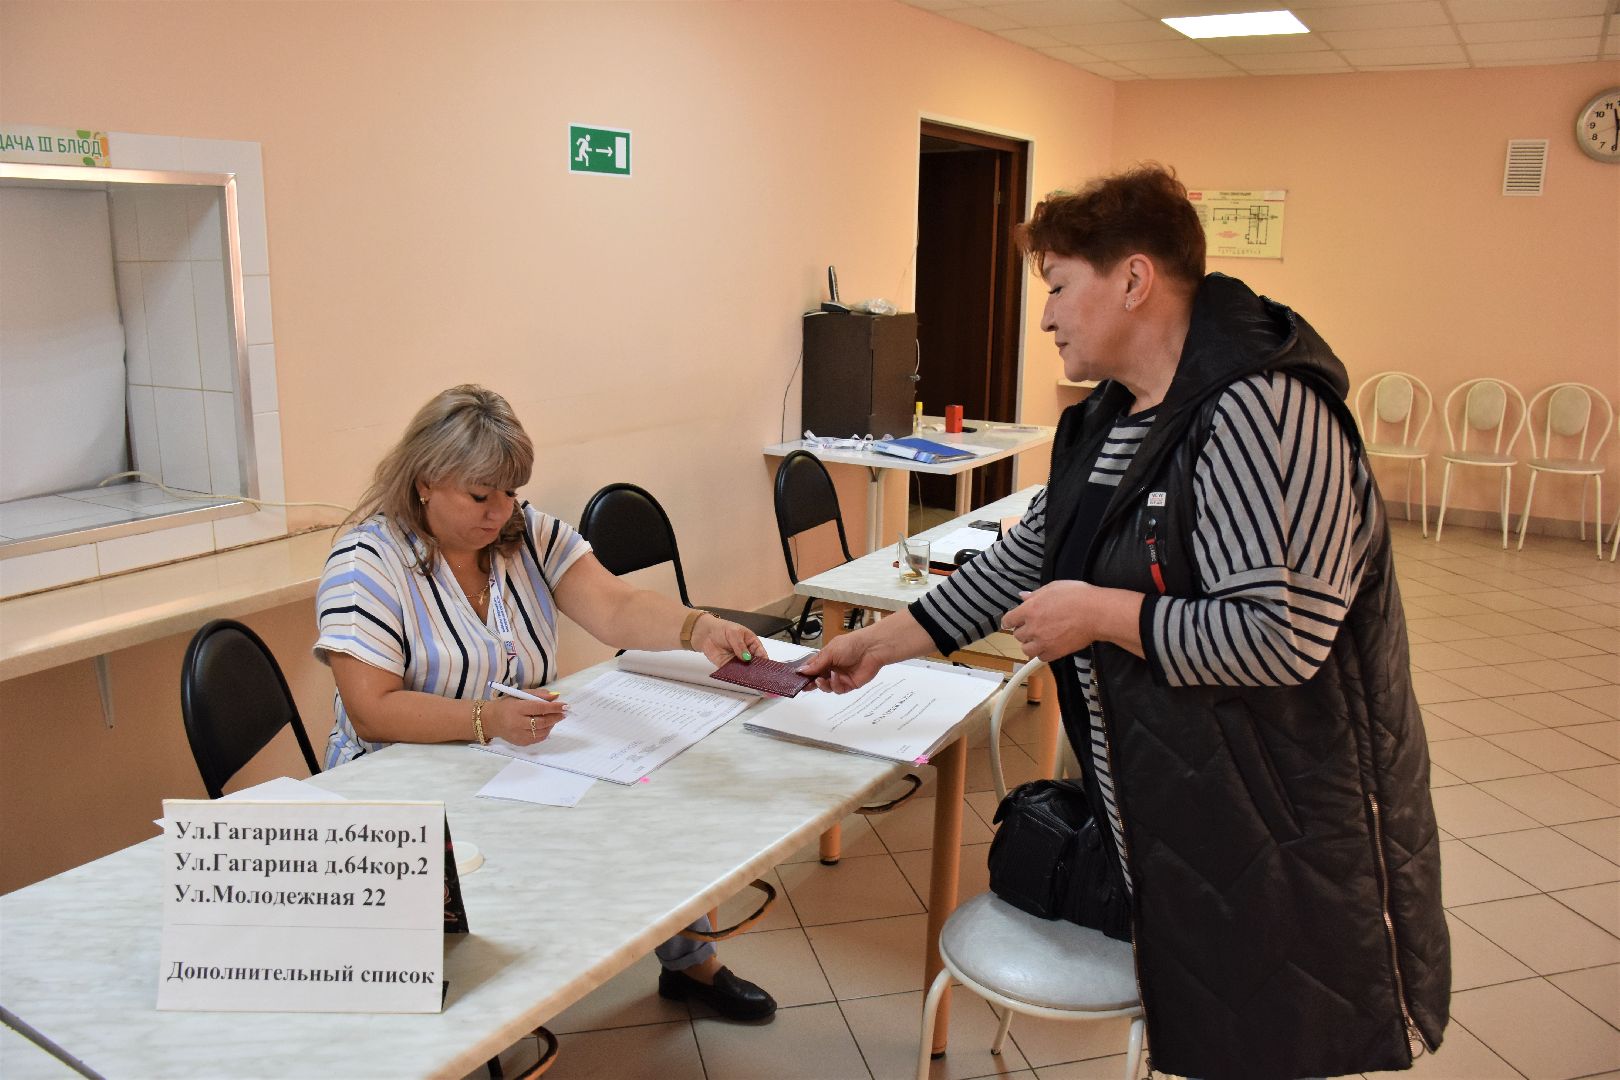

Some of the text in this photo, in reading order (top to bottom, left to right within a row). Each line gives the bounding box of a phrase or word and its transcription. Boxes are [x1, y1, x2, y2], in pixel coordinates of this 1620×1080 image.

[58, 138, 102, 157] БЛЮД
[1592, 133, 1598, 141] 8
[1600, 141, 1606, 149] 7
[175, 821, 428, 848] Ул.Гагарина д.64кор.1
[175, 852, 429, 880] Ул.Гагарина д.64кор.2
[174, 884, 387, 907] Ул.Молодежная 22
[166, 961, 435, 984] Дополнительный список
